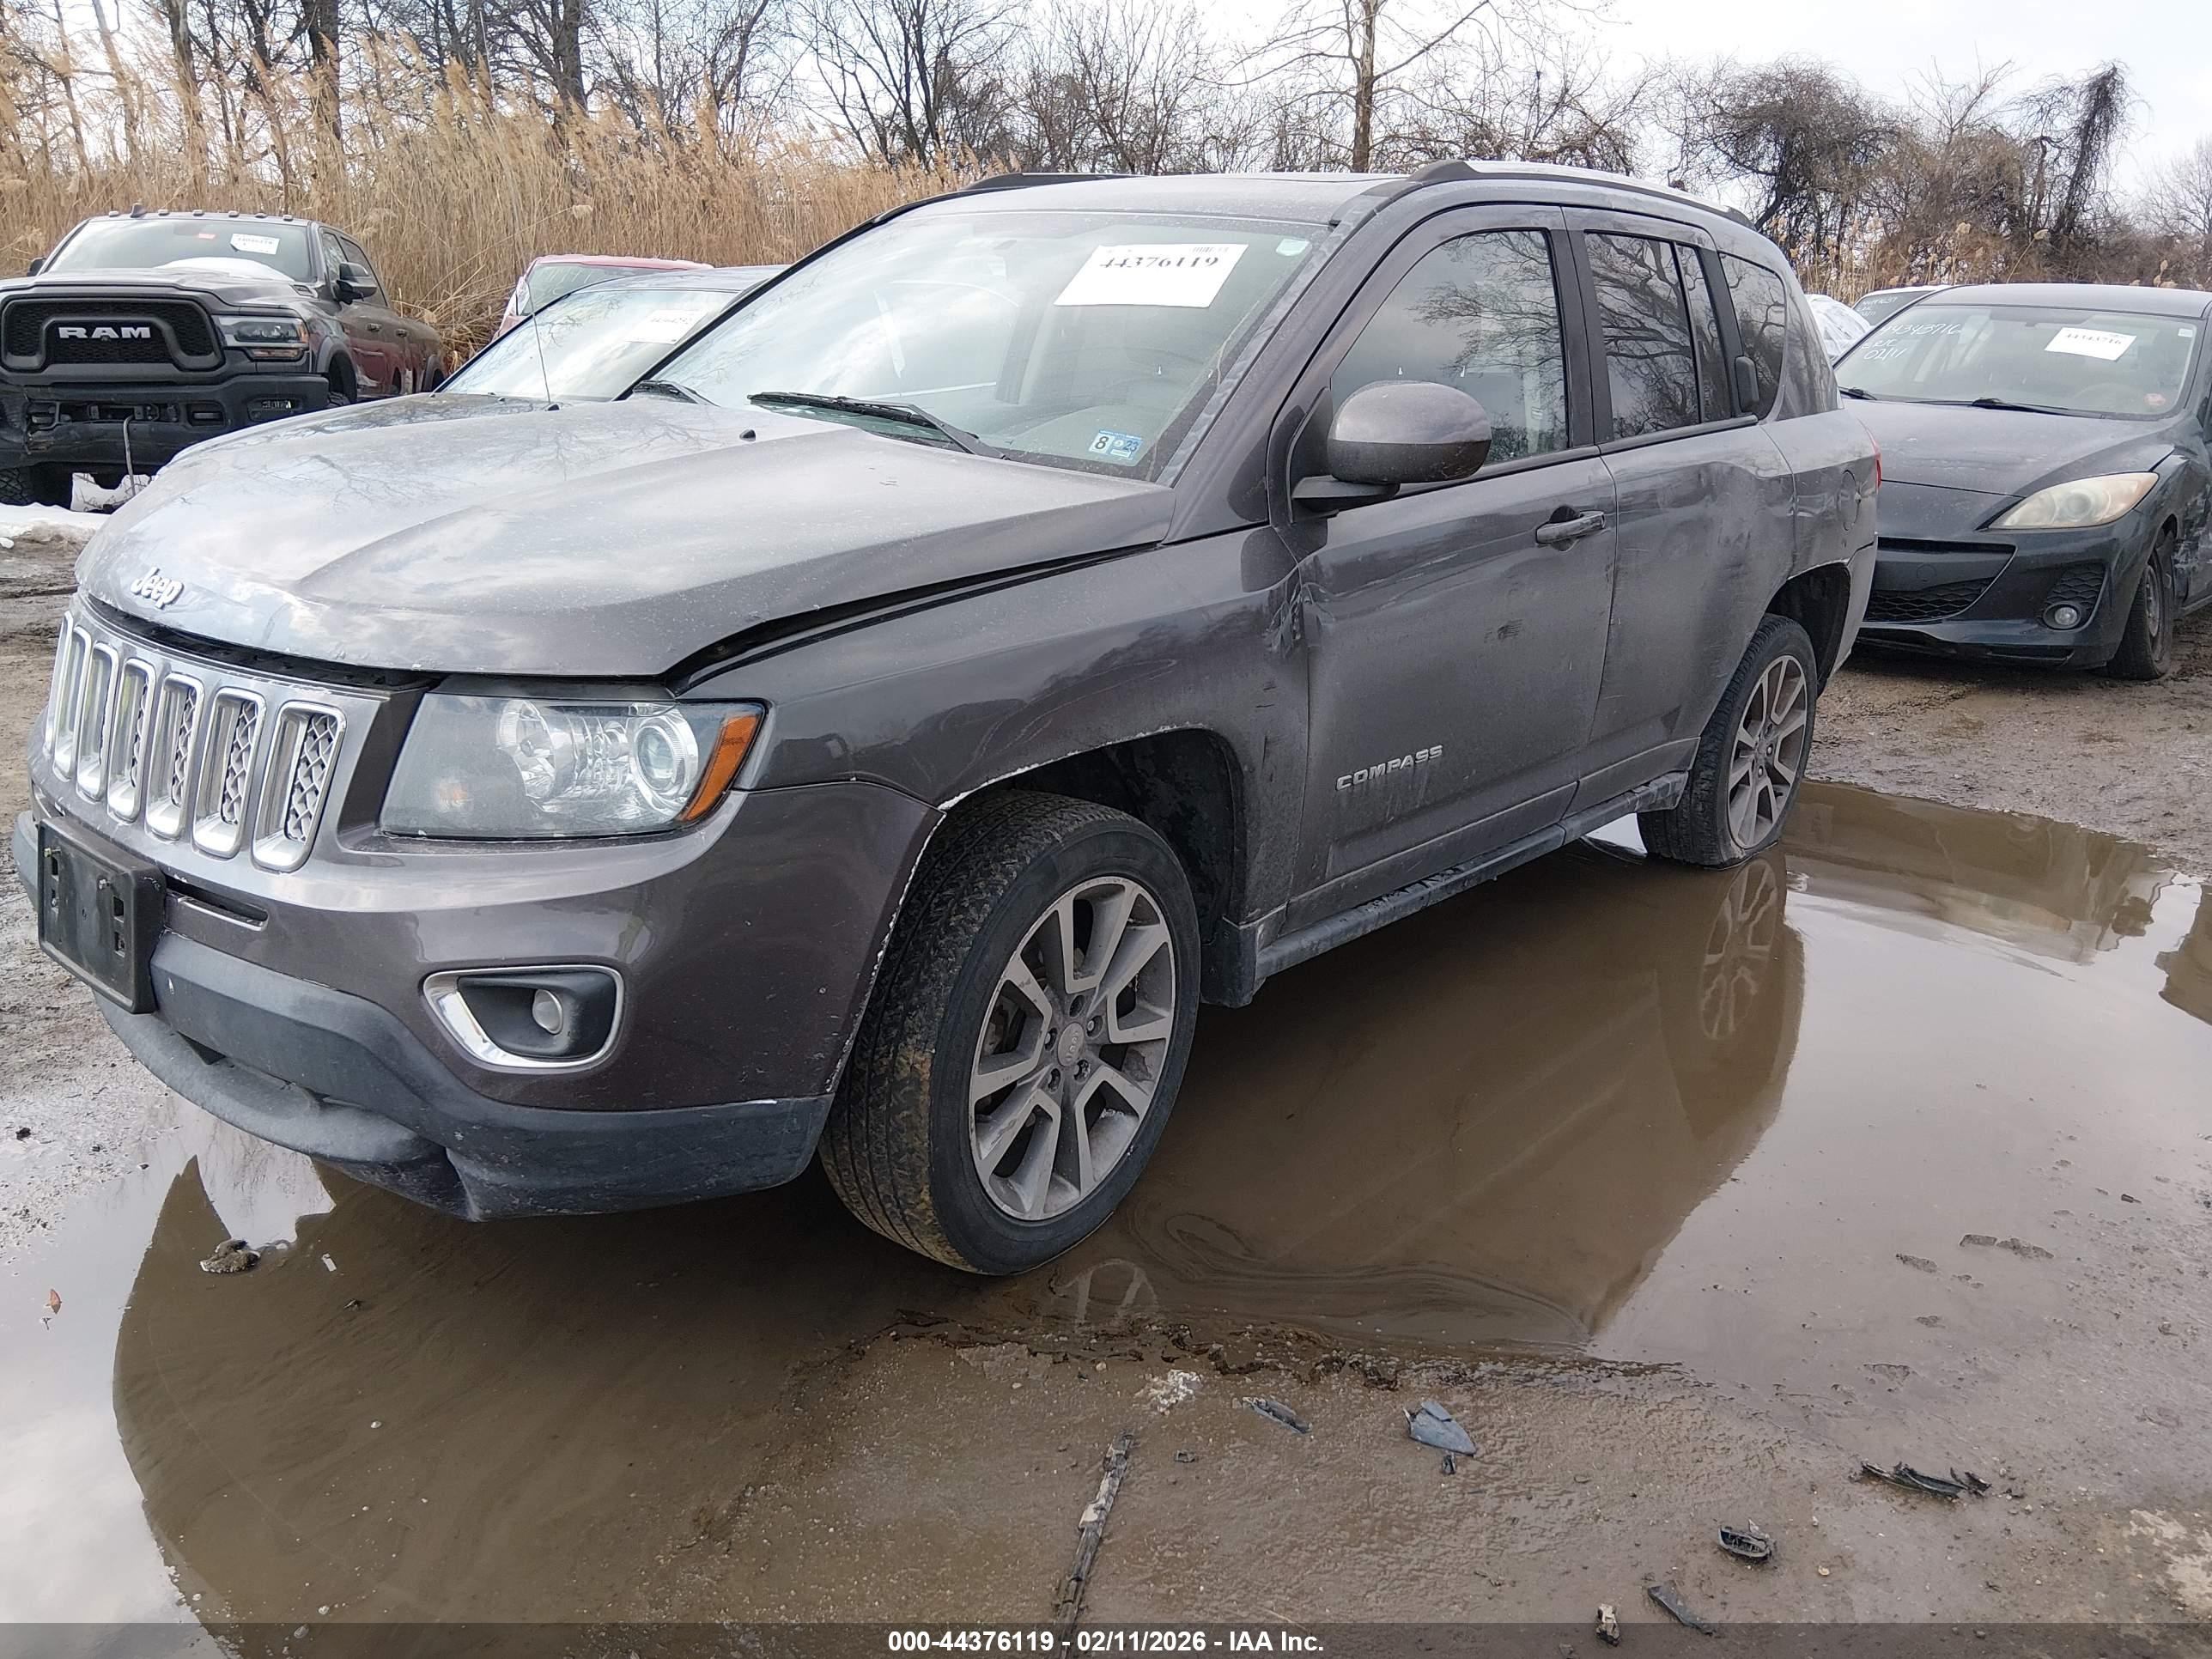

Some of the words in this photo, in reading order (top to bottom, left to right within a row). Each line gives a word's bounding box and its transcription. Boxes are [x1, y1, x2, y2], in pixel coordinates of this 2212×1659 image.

[1100, 257, 1218, 268] 44376119
[58, 326, 151, 339] RAM
[1095, 436, 1109, 449] 8
[1122, 441, 1139, 452] 23
[131, 567, 184, 609] Jeep
[1336, 744, 1443, 790] COMPASS
